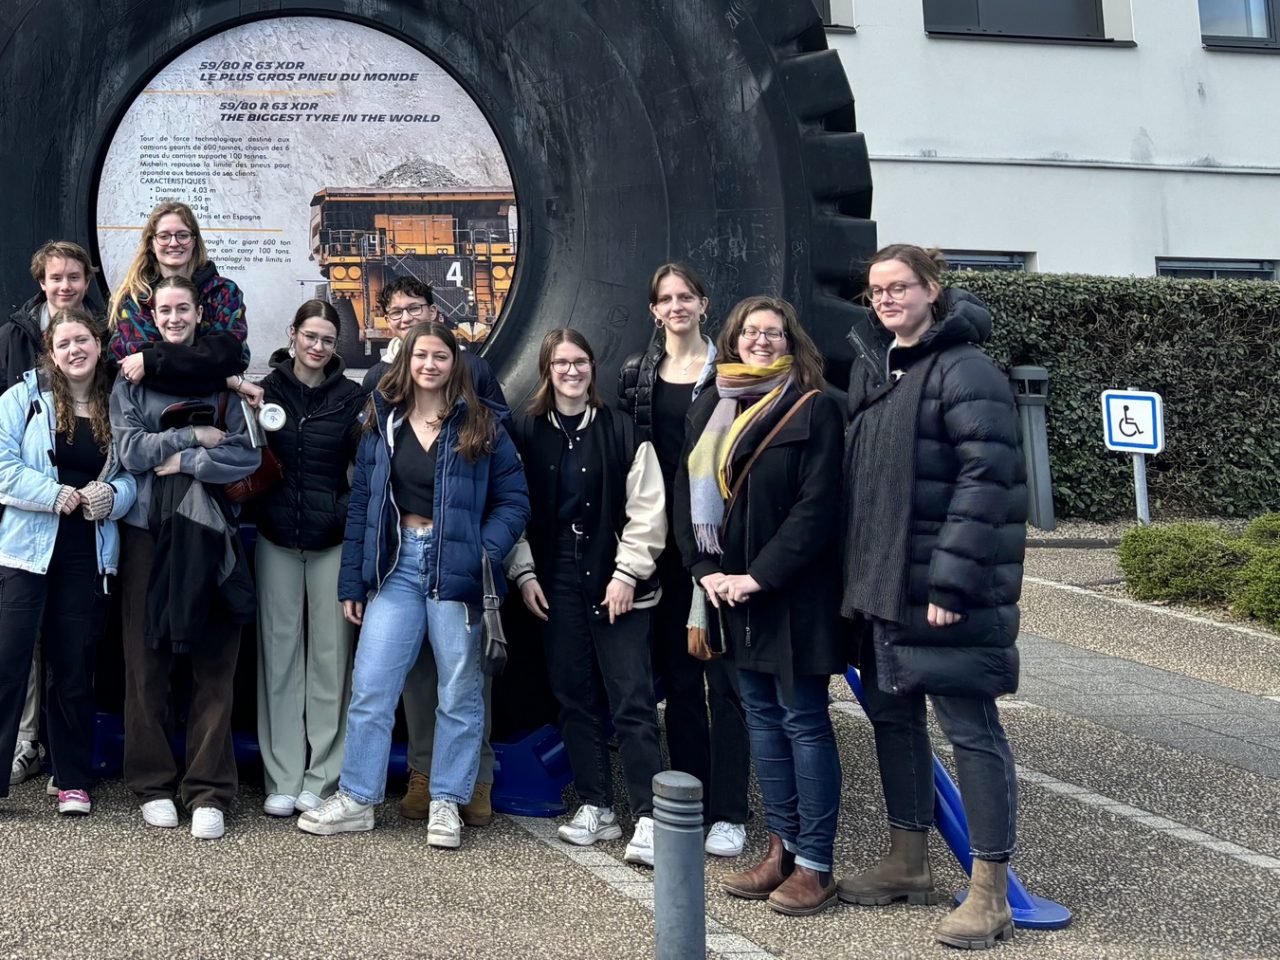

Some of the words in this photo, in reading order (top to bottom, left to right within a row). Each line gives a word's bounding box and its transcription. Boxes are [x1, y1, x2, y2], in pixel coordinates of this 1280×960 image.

[199, 61, 240, 70] 59/80
[242, 61, 252, 70] R
[255, 61, 271, 70] 63
[274, 61, 305, 70] XDR
[200, 73, 217, 82] LE
[220, 73, 254, 82] PLUS
[257, 73, 295, 82] GROS
[297, 73, 337, 82] PNEU
[340, 73, 359, 82] DU
[363, 73, 420, 82] MONDE
[219, 102, 257, 111] 59/80
[259, 102, 269, 111] R
[271, 102, 288, 111] 63
[291, 102, 319, 111] XDR
[220, 114, 246, 123] THE
[247, 114, 303, 123] BIGGEST
[306, 114, 340, 123] TYRE
[342, 114, 359, 123] IN
[362, 114, 385, 123] THE
[390, 114, 440, 123] WORLD
[446, 261, 463, 287] 4
